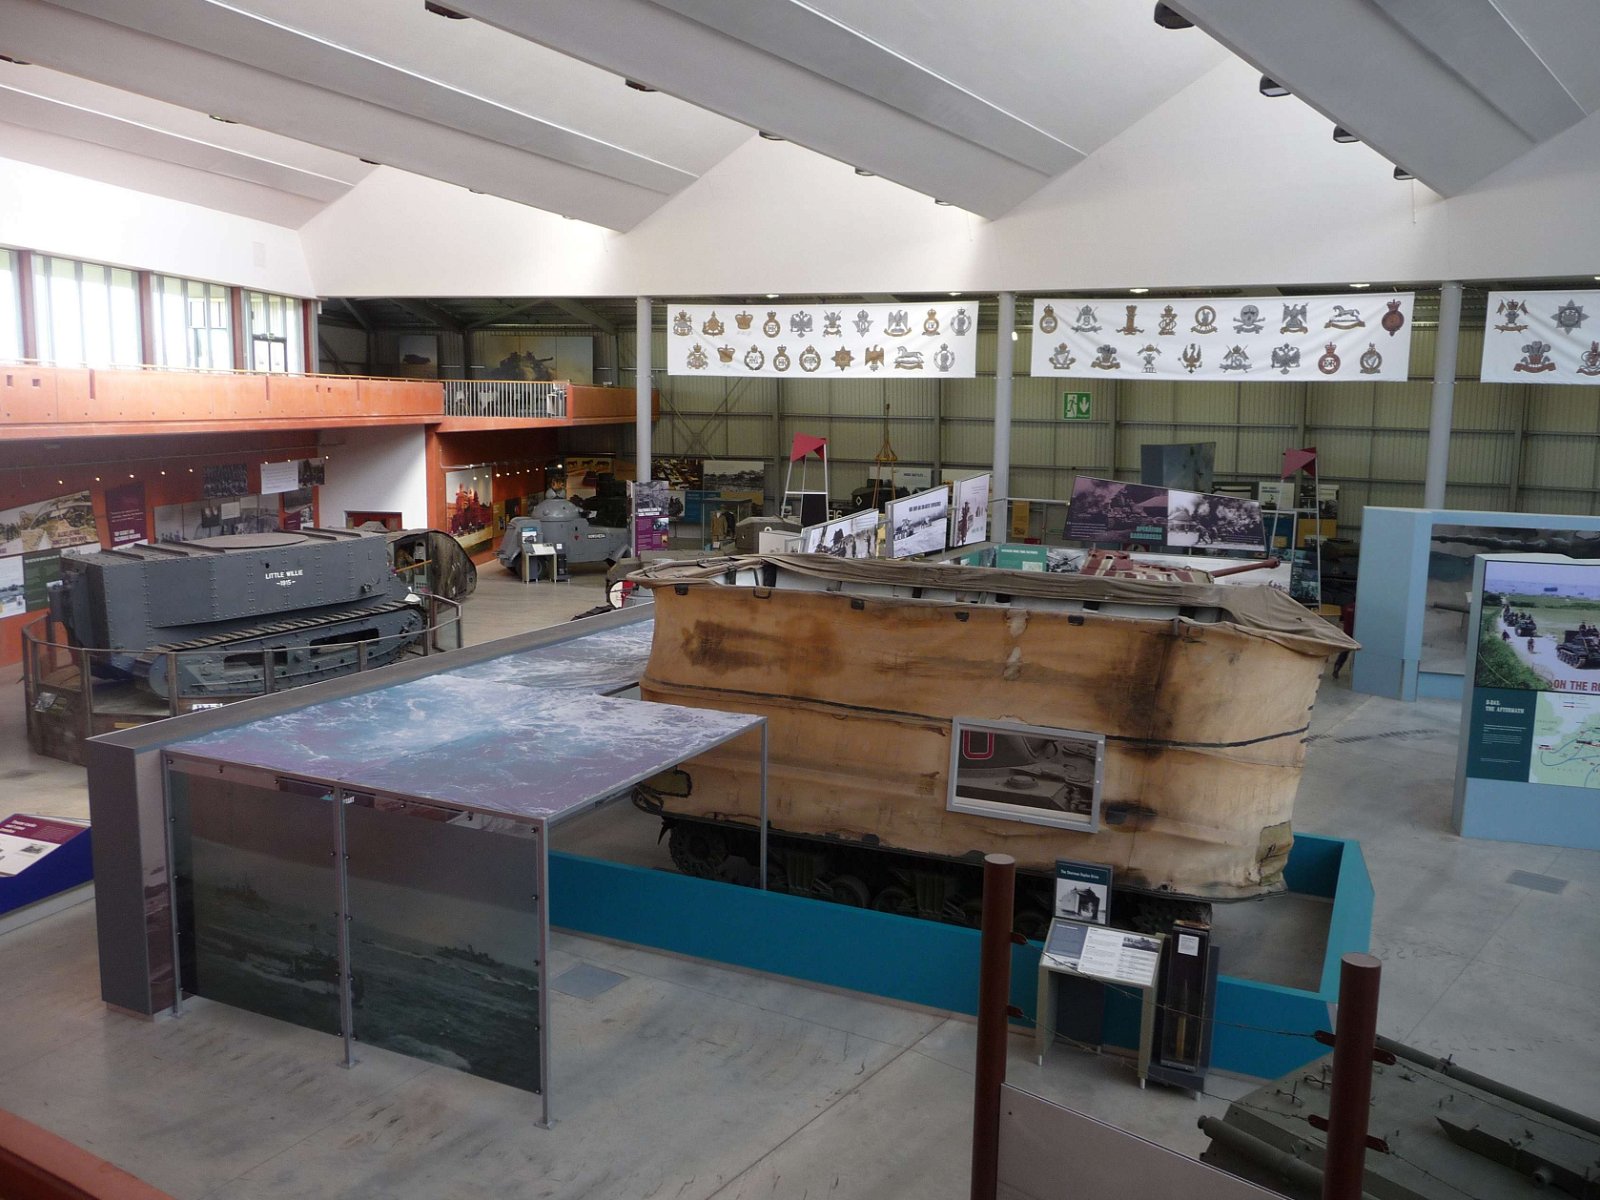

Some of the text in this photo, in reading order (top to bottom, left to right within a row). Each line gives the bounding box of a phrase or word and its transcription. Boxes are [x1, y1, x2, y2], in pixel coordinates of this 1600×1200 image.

[265, 569, 304, 580] LITTLE WILLIE
[1570, 680, 1588, 692] THE
